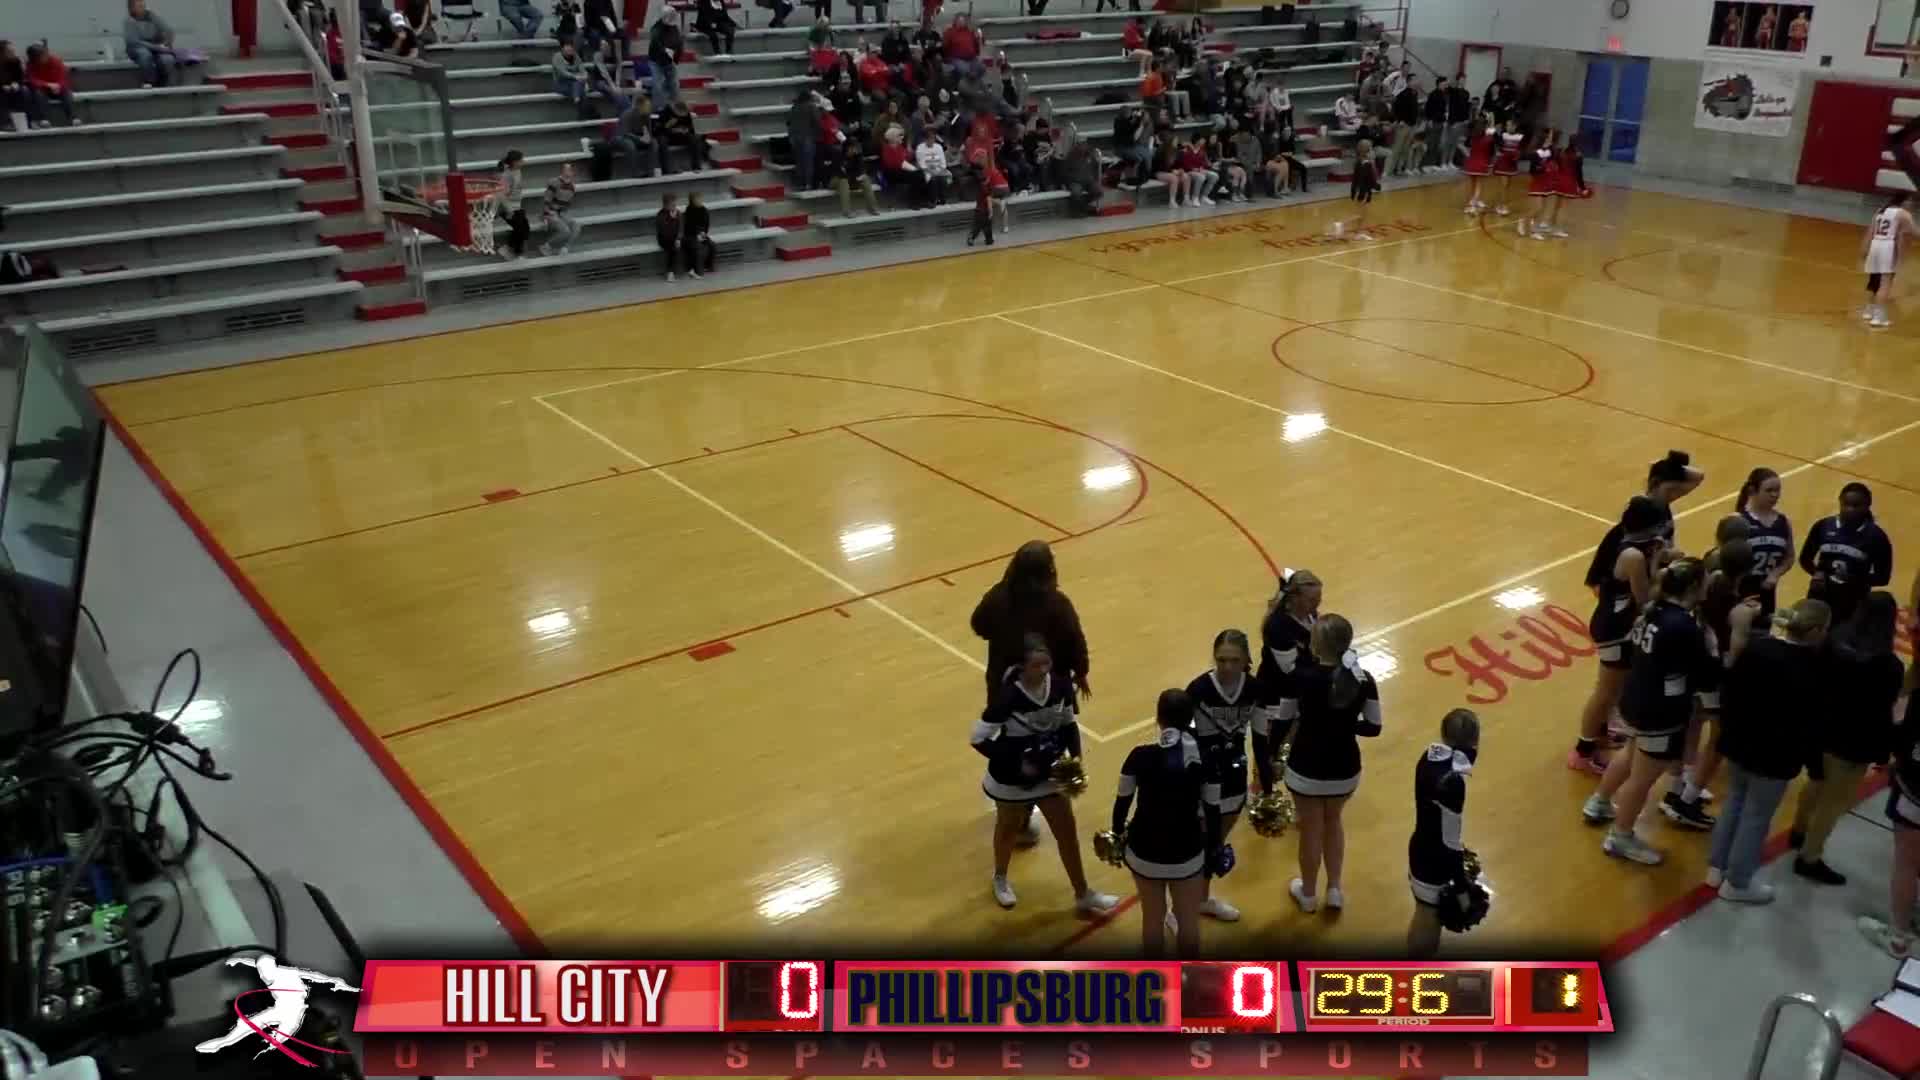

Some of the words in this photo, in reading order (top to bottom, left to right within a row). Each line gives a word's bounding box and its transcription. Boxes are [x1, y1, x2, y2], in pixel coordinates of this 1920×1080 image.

[1424, 604, 1599, 704] Hill
[780, 961, 818, 1019] 0
[1232, 966, 1274, 1018] 0
[1557, 973, 1582, 1008] 1
[1377, 1017, 1430, 1025] PERIOD
